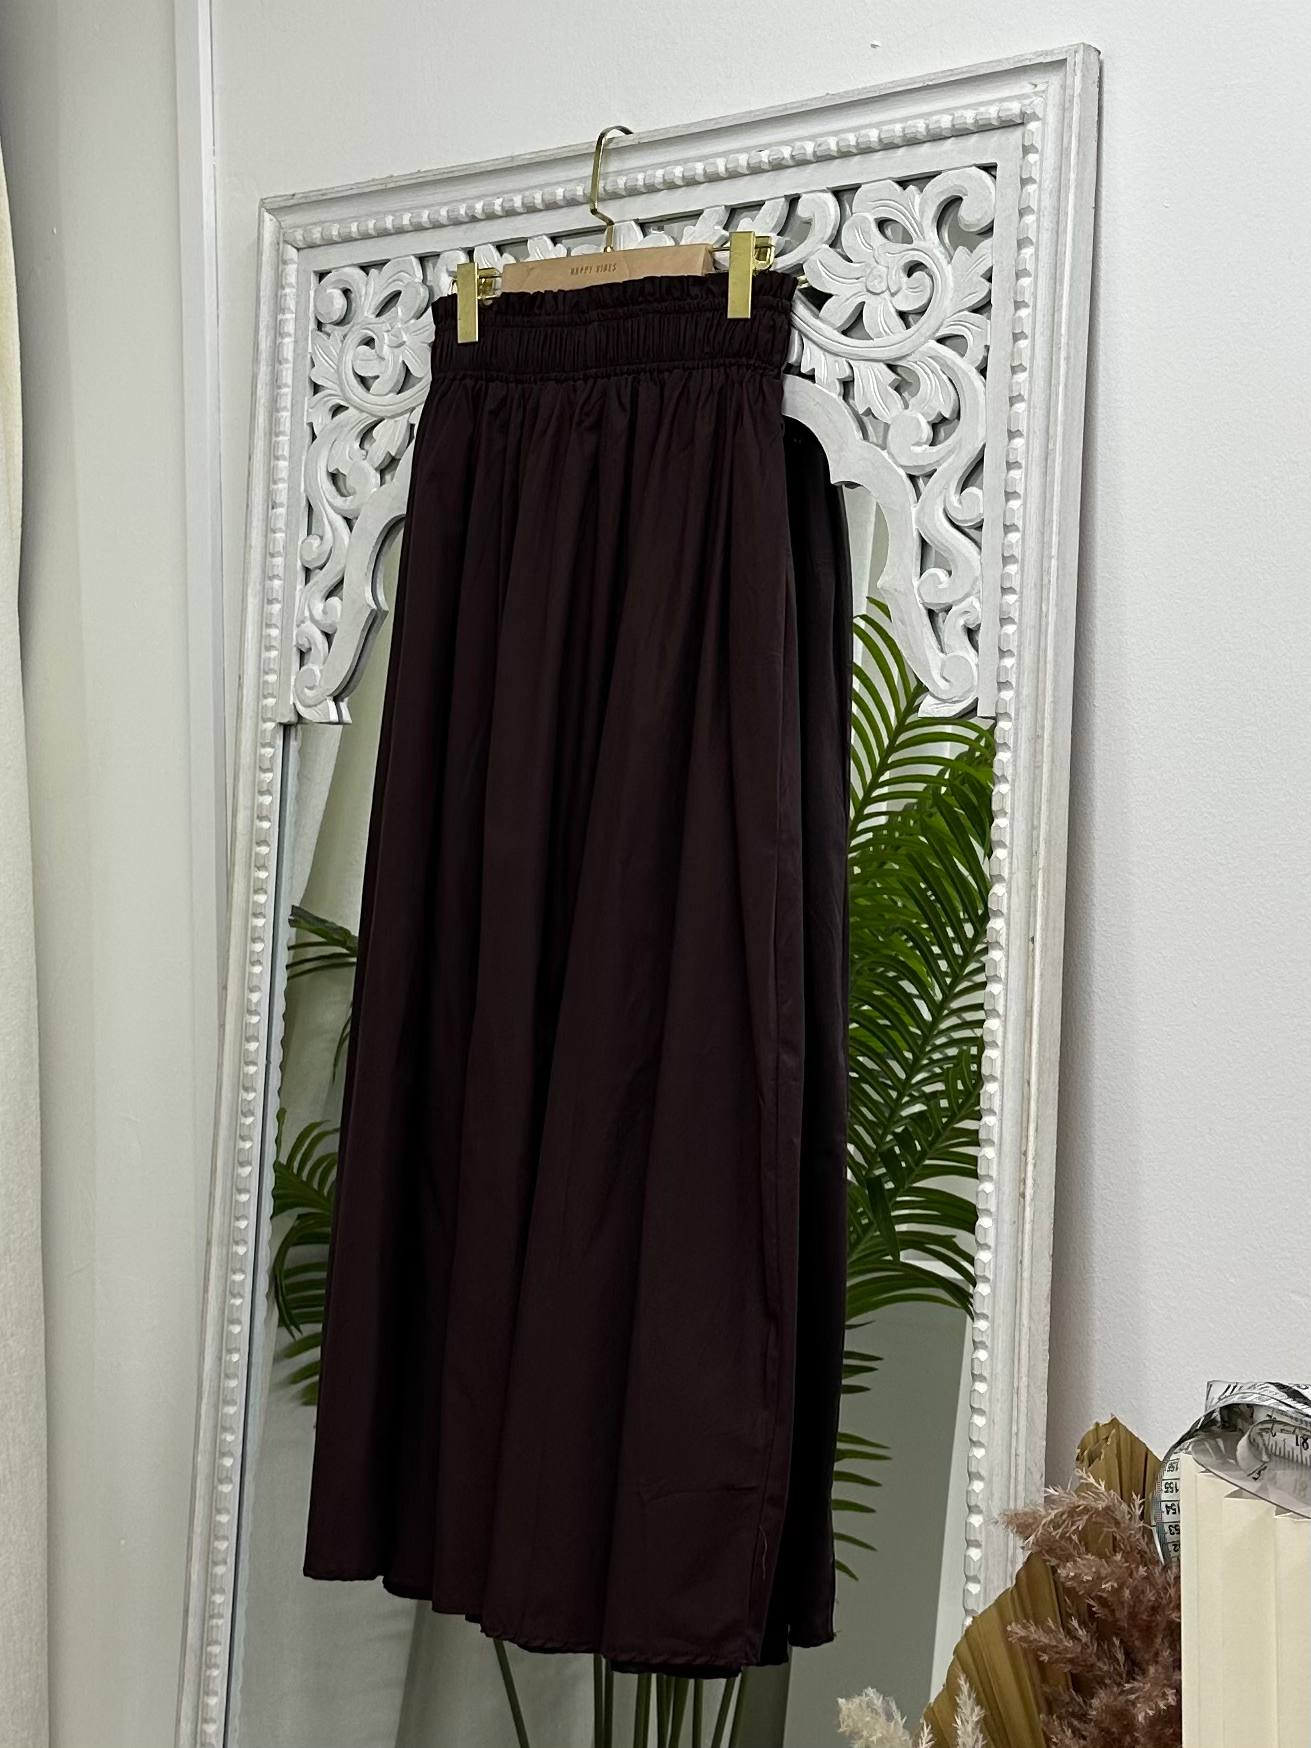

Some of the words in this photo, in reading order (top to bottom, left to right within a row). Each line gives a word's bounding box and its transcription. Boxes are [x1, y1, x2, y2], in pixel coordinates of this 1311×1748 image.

[571, 265, 593, 275] HAPPY
[596, 263, 617, 273] VIBES
[1164, 1482, 1179, 1493] 155
[1165, 1503, 1180, 1515] 154
[1168, 1524, 1180, 1536] 53
